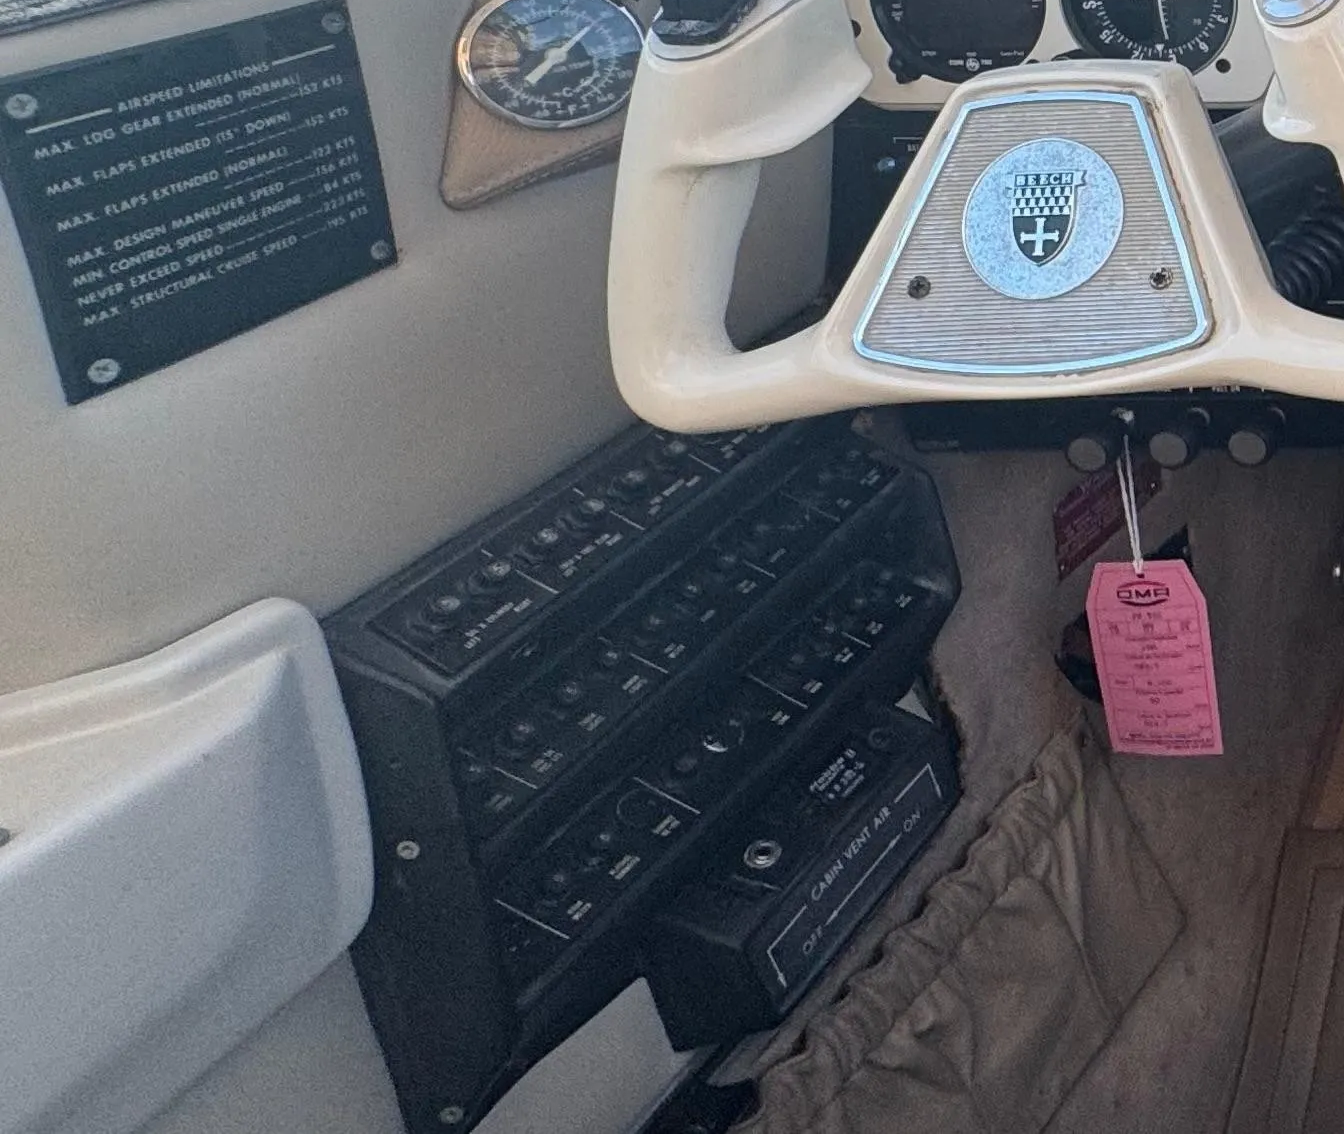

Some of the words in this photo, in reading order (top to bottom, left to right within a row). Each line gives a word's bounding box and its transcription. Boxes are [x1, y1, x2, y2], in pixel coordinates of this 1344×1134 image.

[1083, 0, 1097, 10] S
[117, 86, 184, 113] AIRSPEED
[188, 61, 270, 93] LIMITATIONS
[322, 74, 343, 90] KTS
[83, 128, 116, 147] LDG
[121, 115, 161, 135] GEAR
[166, 93, 233, 123] EXTENDED
[238, 72, 301, 102] (NORMAL)
[328, 105, 349, 121] KTS
[92, 157, 136, 183] FLAPS
[140, 136, 211, 167] EXTENDED
[245, 111, 291, 132] DOWN)
[335, 136, 355, 151] KTS
[104, 194, 148, 217] FLAPS
[152, 170, 219, 201] EXTENDED
[1015, 173, 1073, 186] BEECH
[108, 242, 173, 276] CONTROL
[175, 227, 214, 250] SPEED
[342, 171, 362, 186] KTS
[113, 224, 168, 252] DESIGN
[171, 195, 245, 230] MANEUVER
[250, 182, 285, 203] SPEED
[76, 282, 125, 308] NEVER
[129, 260, 182, 289] EXCEED
[186, 243, 224, 267] SPEED
[129, 270, 215, 309] STRUCTURAL
[262, 234, 298, 256] SPEED
[903, 809, 922, 833] ON
[811, 858, 846, 902] CABIN
[843, 826, 872, 861] VENT
[873, 805, 892, 831] AIR
[802, 925, 823, 954] OFF
